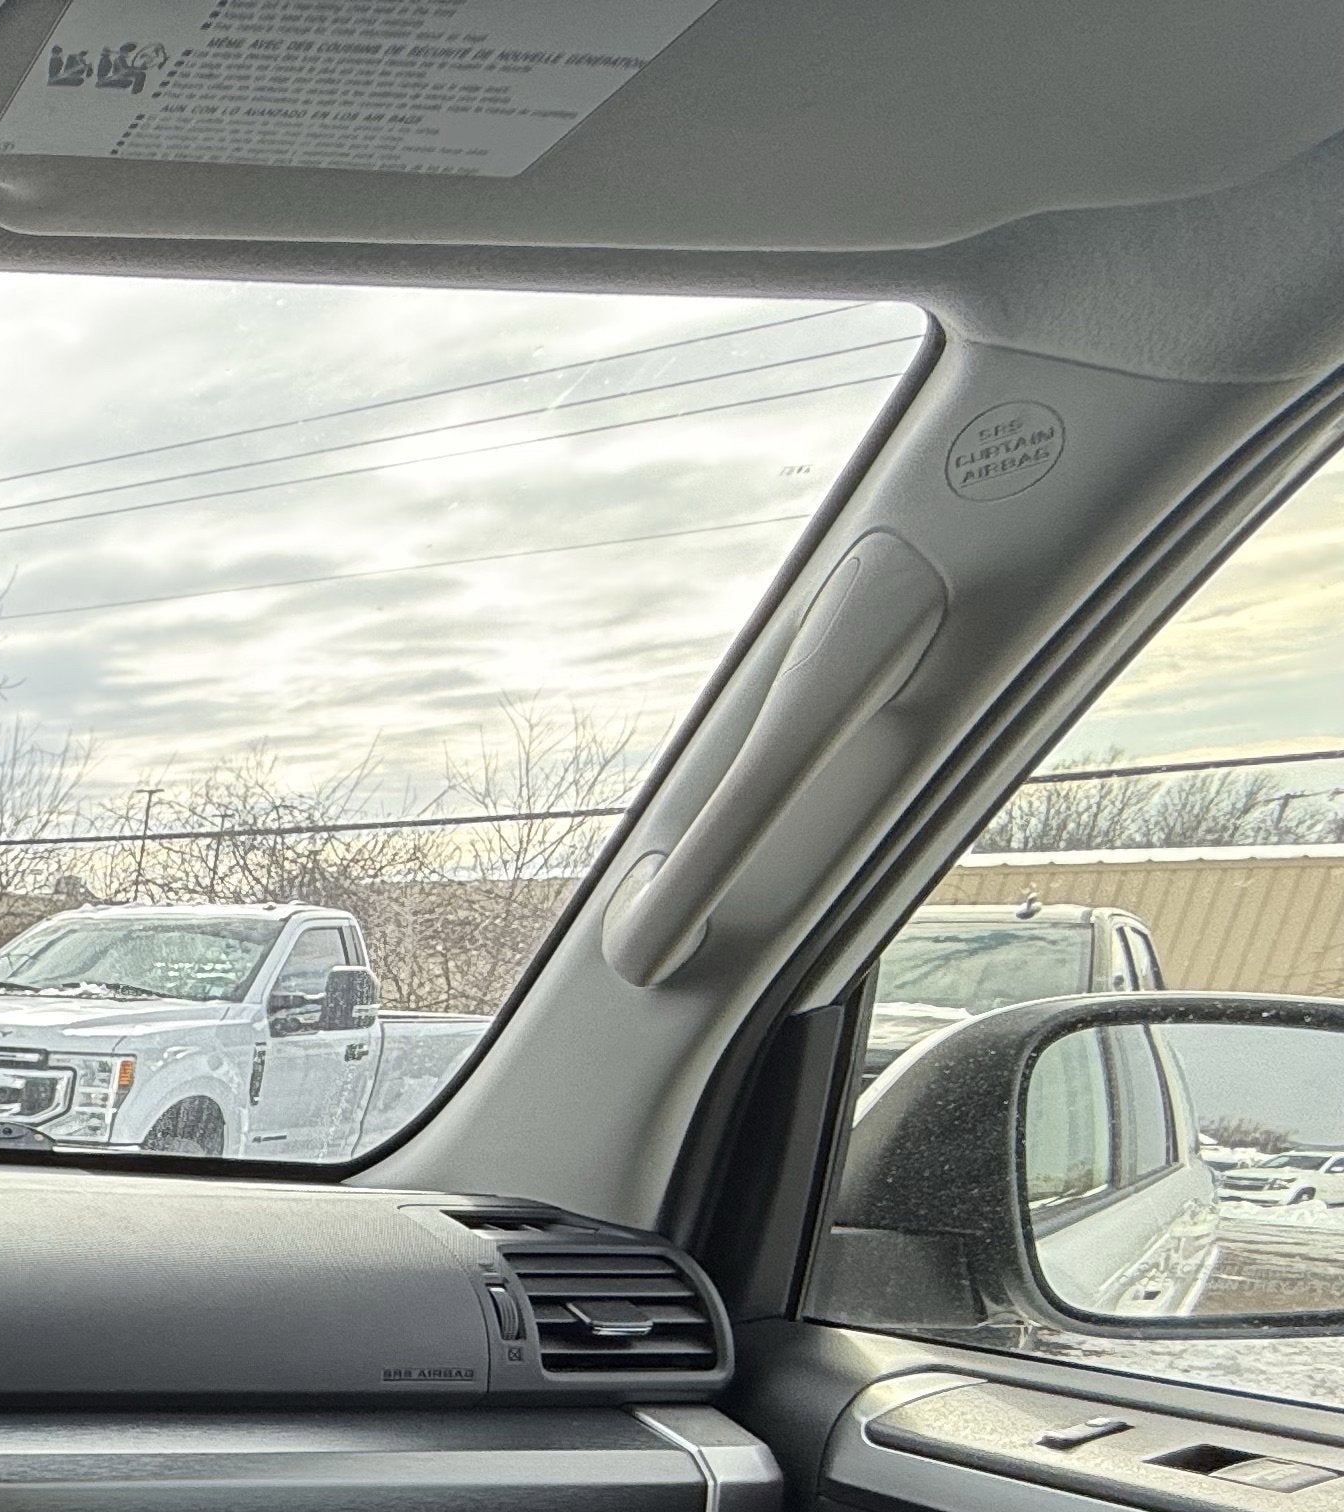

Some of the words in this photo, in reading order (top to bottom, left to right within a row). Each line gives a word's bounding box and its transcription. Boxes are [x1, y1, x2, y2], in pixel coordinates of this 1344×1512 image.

[955, 426, 1055, 469] CURTAIN
[979, 419, 1024, 442] SRS
[962, 448, 1050, 484] AIRBAG
